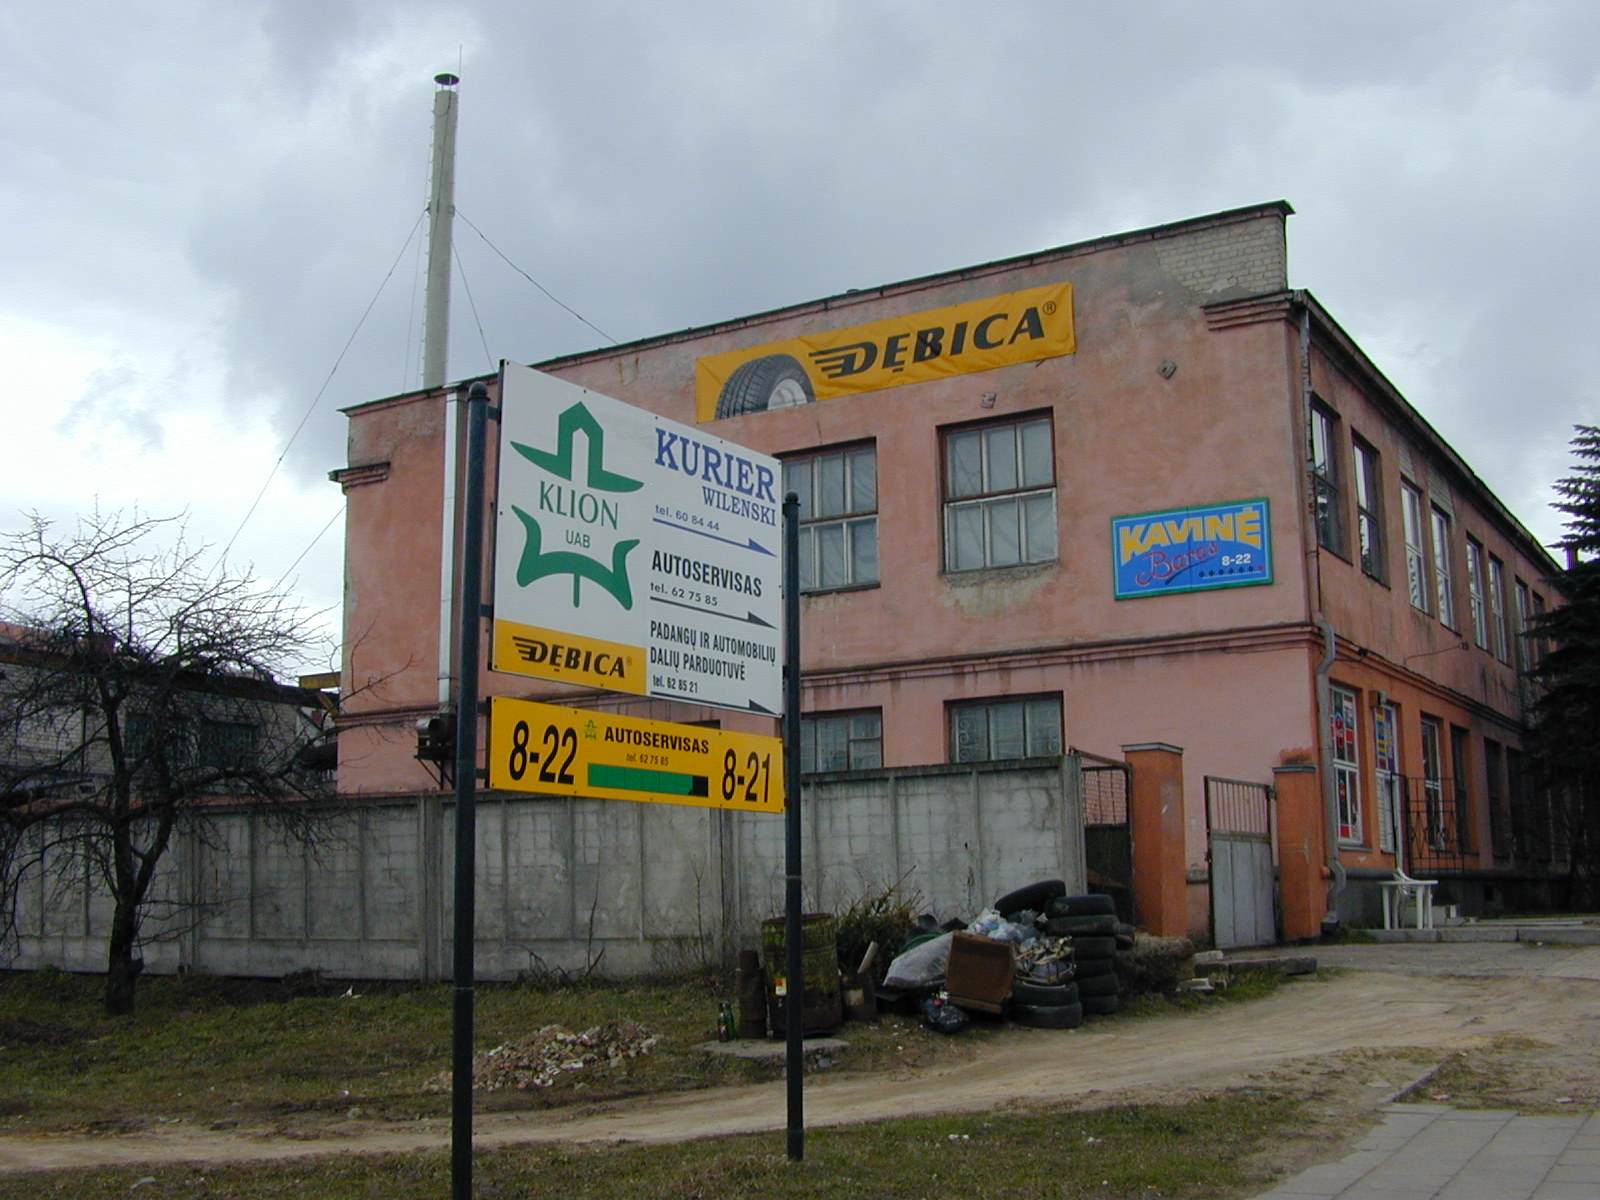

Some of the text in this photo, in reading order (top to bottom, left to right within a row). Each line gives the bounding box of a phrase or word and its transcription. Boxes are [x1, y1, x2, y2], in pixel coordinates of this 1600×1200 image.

[654, 427, 777, 504] KURIER
[539, 480, 618, 530] KLION
[655, 504, 720, 532] tel. 60 84 44
[702, 485, 776, 527] WILENSKI
[565, 529, 591, 549] UAB
[651, 549, 762, 598] AUTOSERVISAS
[1221, 553, 1252, 567] 8-22
[650, 582, 718, 607] tel. 62 75 85
[700, 631, 710, 649] IR
[689, 682, 698, 693] 21
[509, 720, 577, 786] 8-22
[604, 726, 709, 755] AUTOSERVISAS
[722, 748, 771, 804] 8-21
